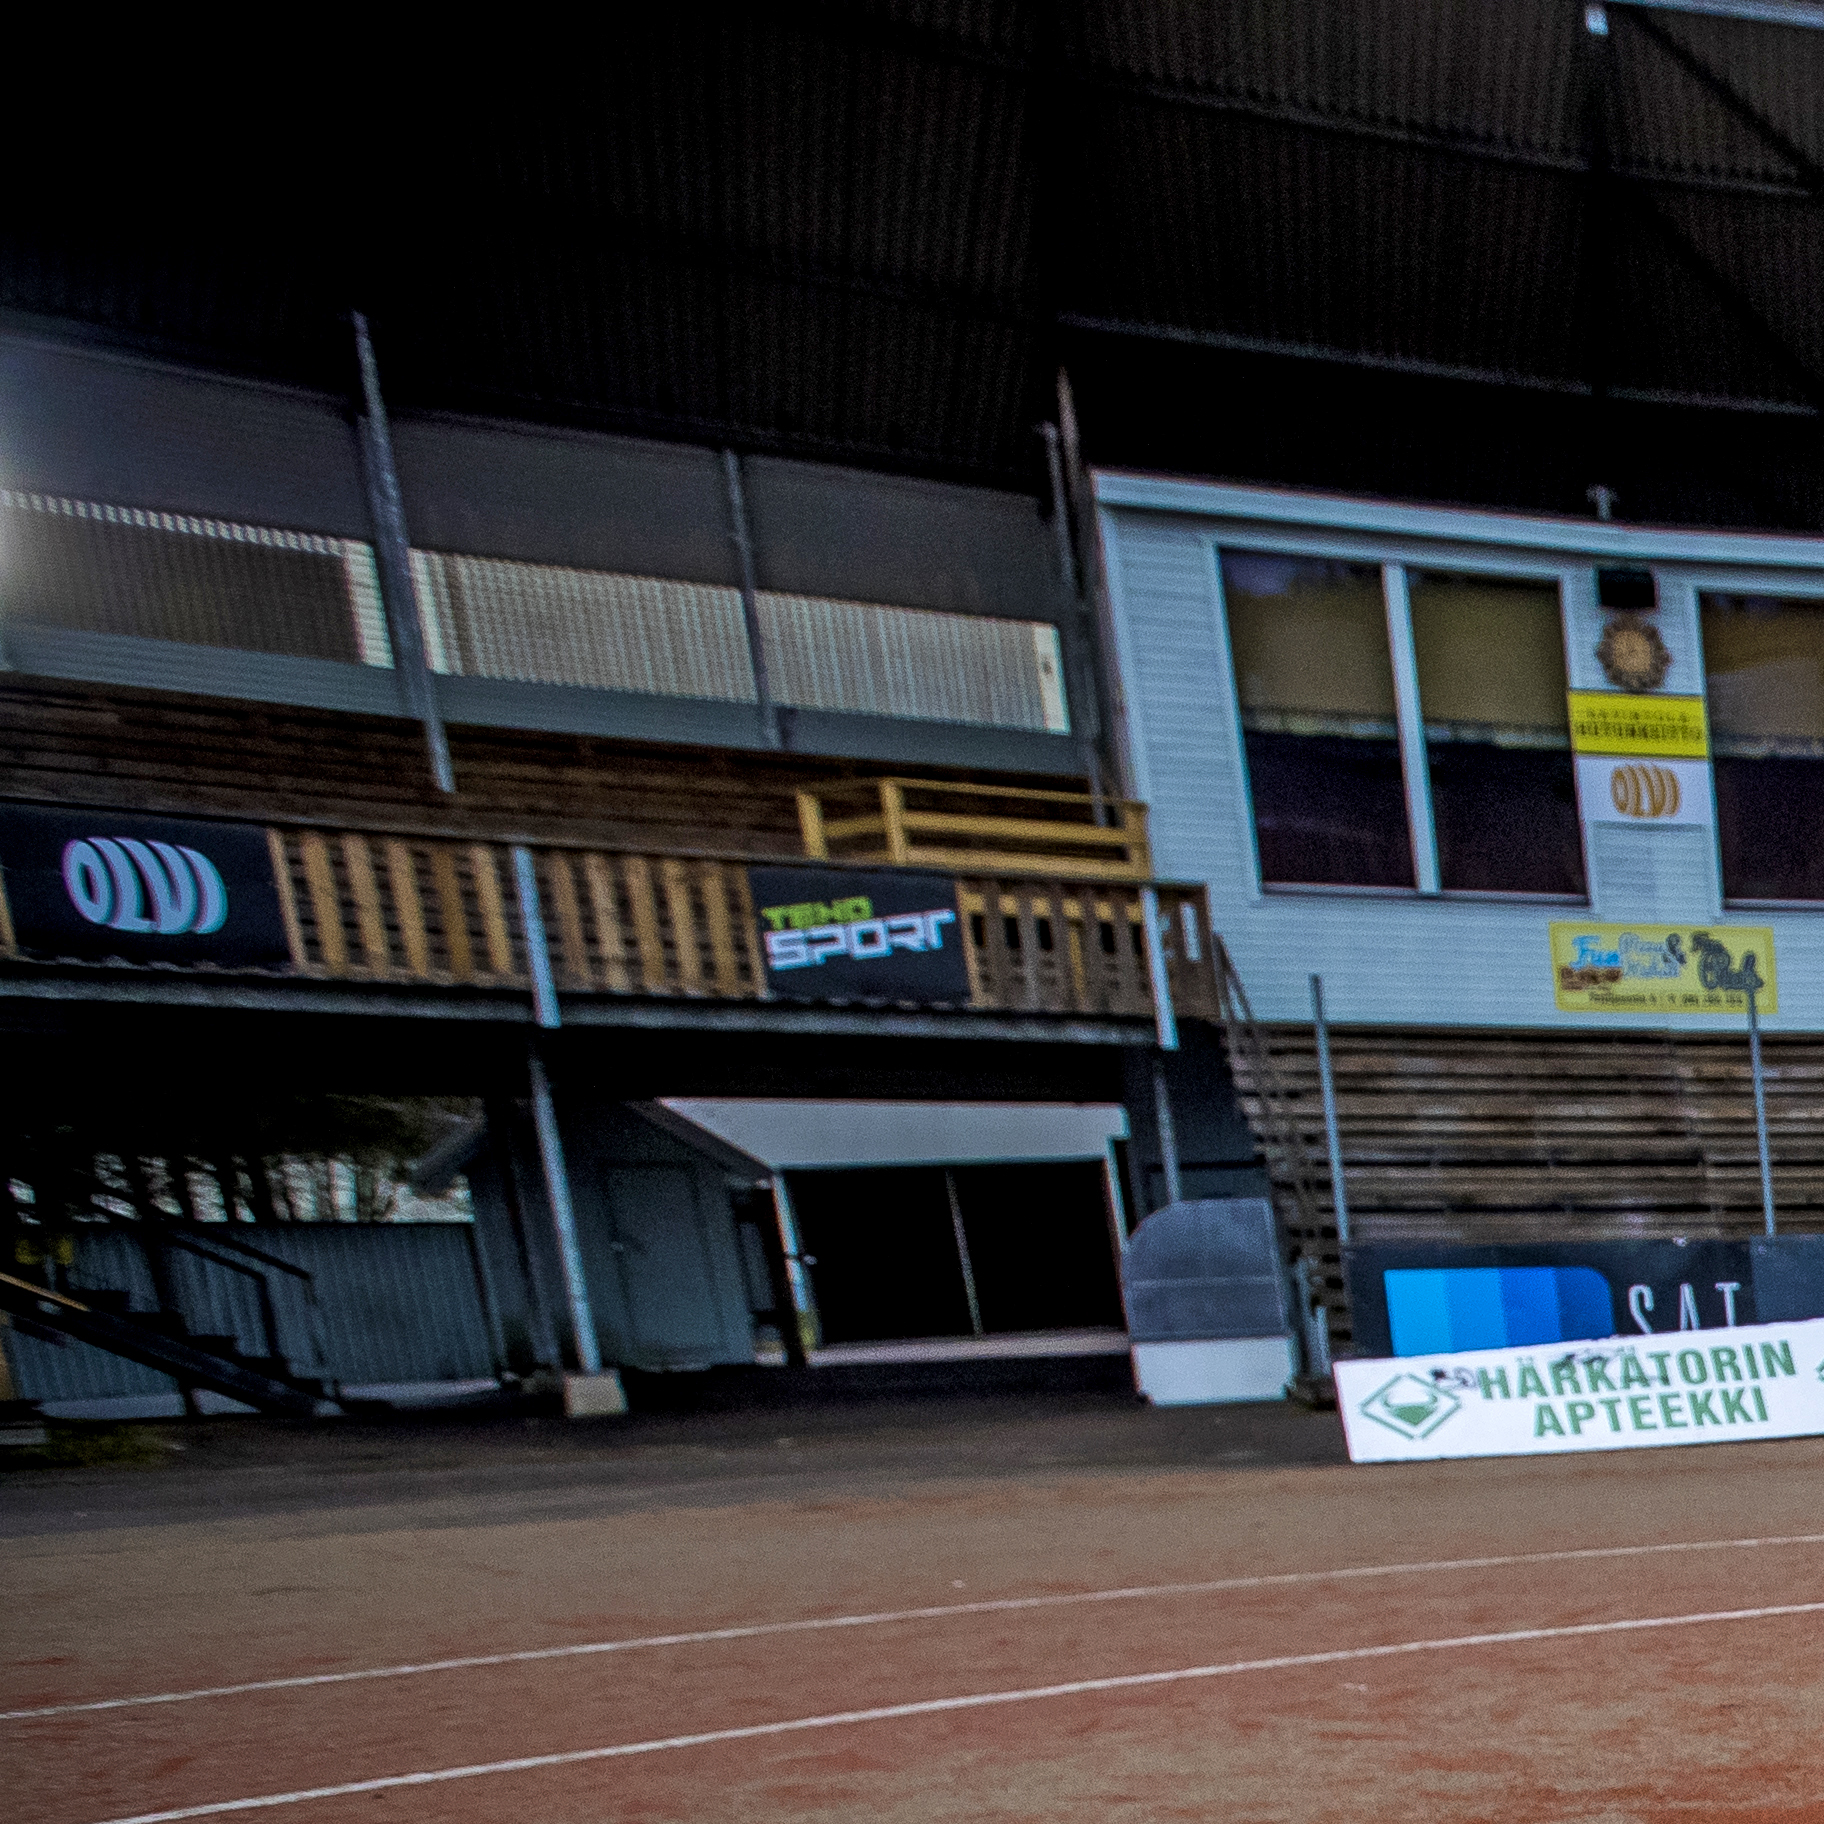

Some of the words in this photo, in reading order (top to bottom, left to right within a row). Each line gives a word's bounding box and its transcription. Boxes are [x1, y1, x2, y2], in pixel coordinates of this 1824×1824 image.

[761, 895, 875, 932] TEHO
[763, 908, 956, 971] SPORT
[1476, 1339, 1798, 1401] HÄRKÄTORIN
[1533, 1385, 1770, 1438] APTEEKKI
